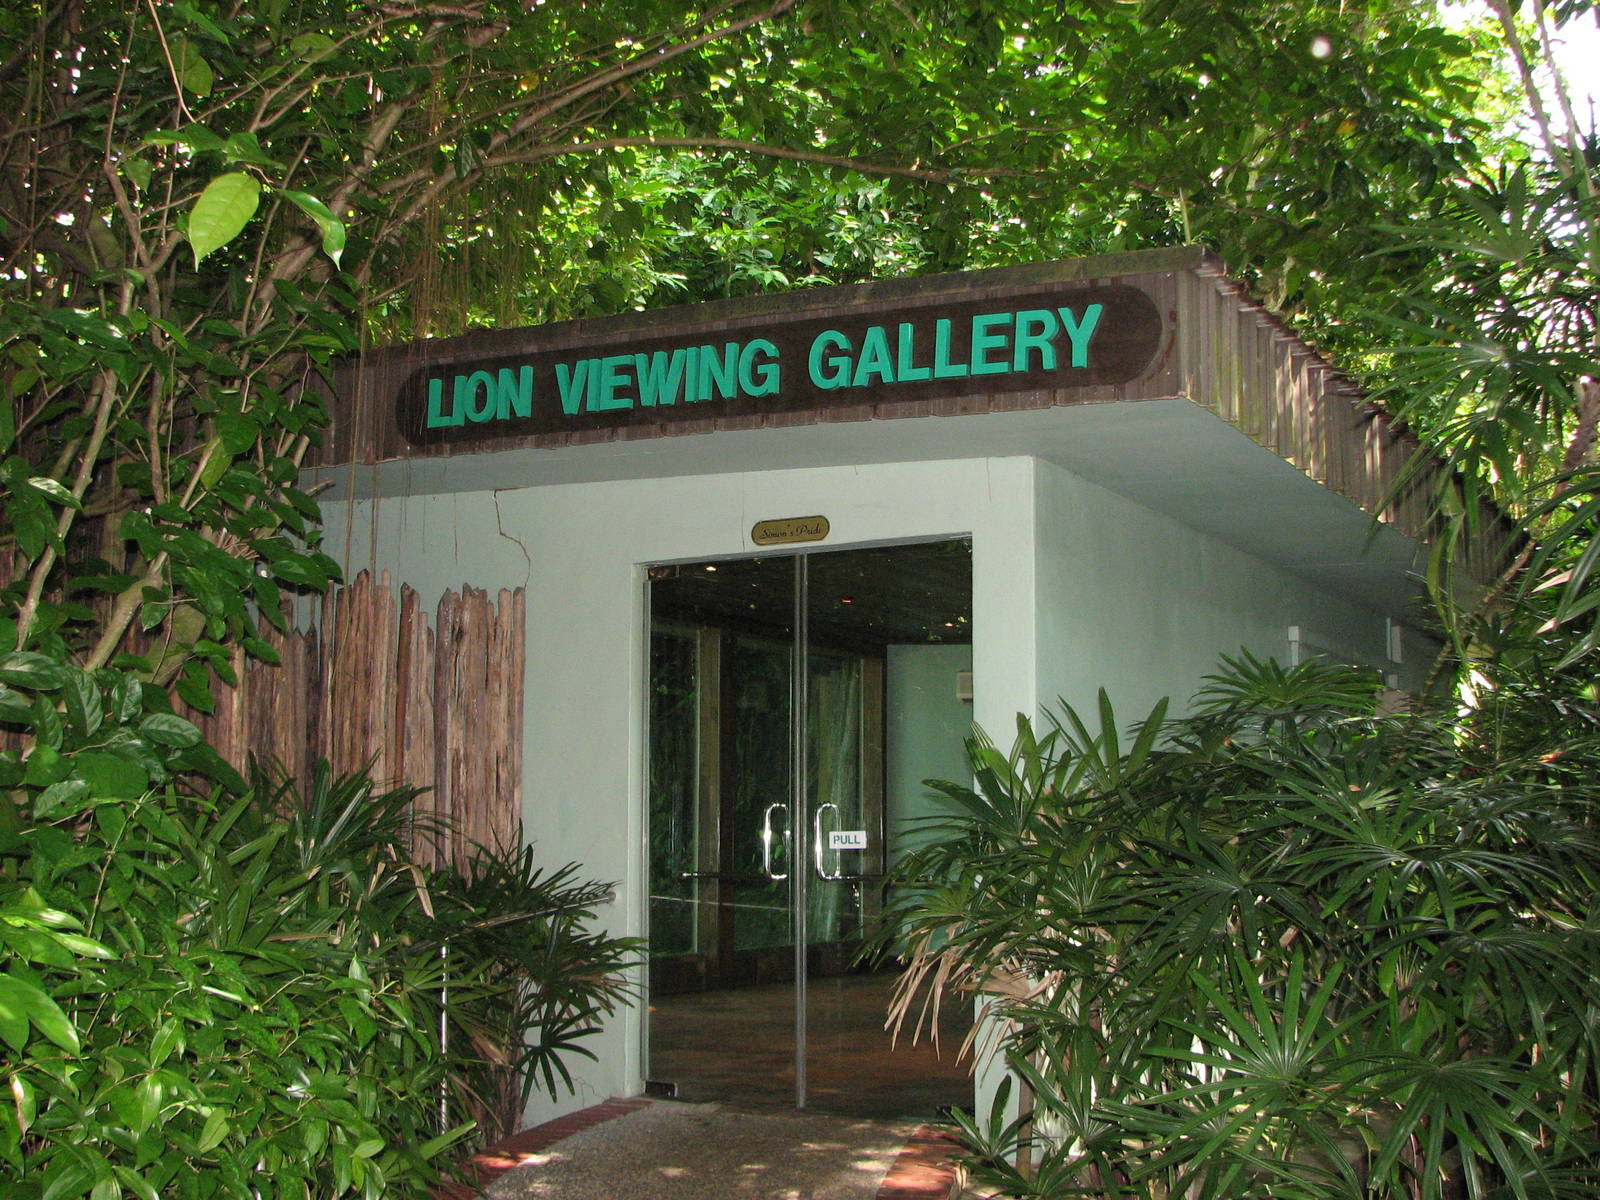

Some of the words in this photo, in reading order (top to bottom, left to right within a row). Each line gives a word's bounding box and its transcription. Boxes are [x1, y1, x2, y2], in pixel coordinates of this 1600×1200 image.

[427, 366, 533, 428] LION
[555, 339, 780, 415] VIEWING
[808, 303, 1103, 390] GALLERY
[833, 835, 861, 844] PULL
